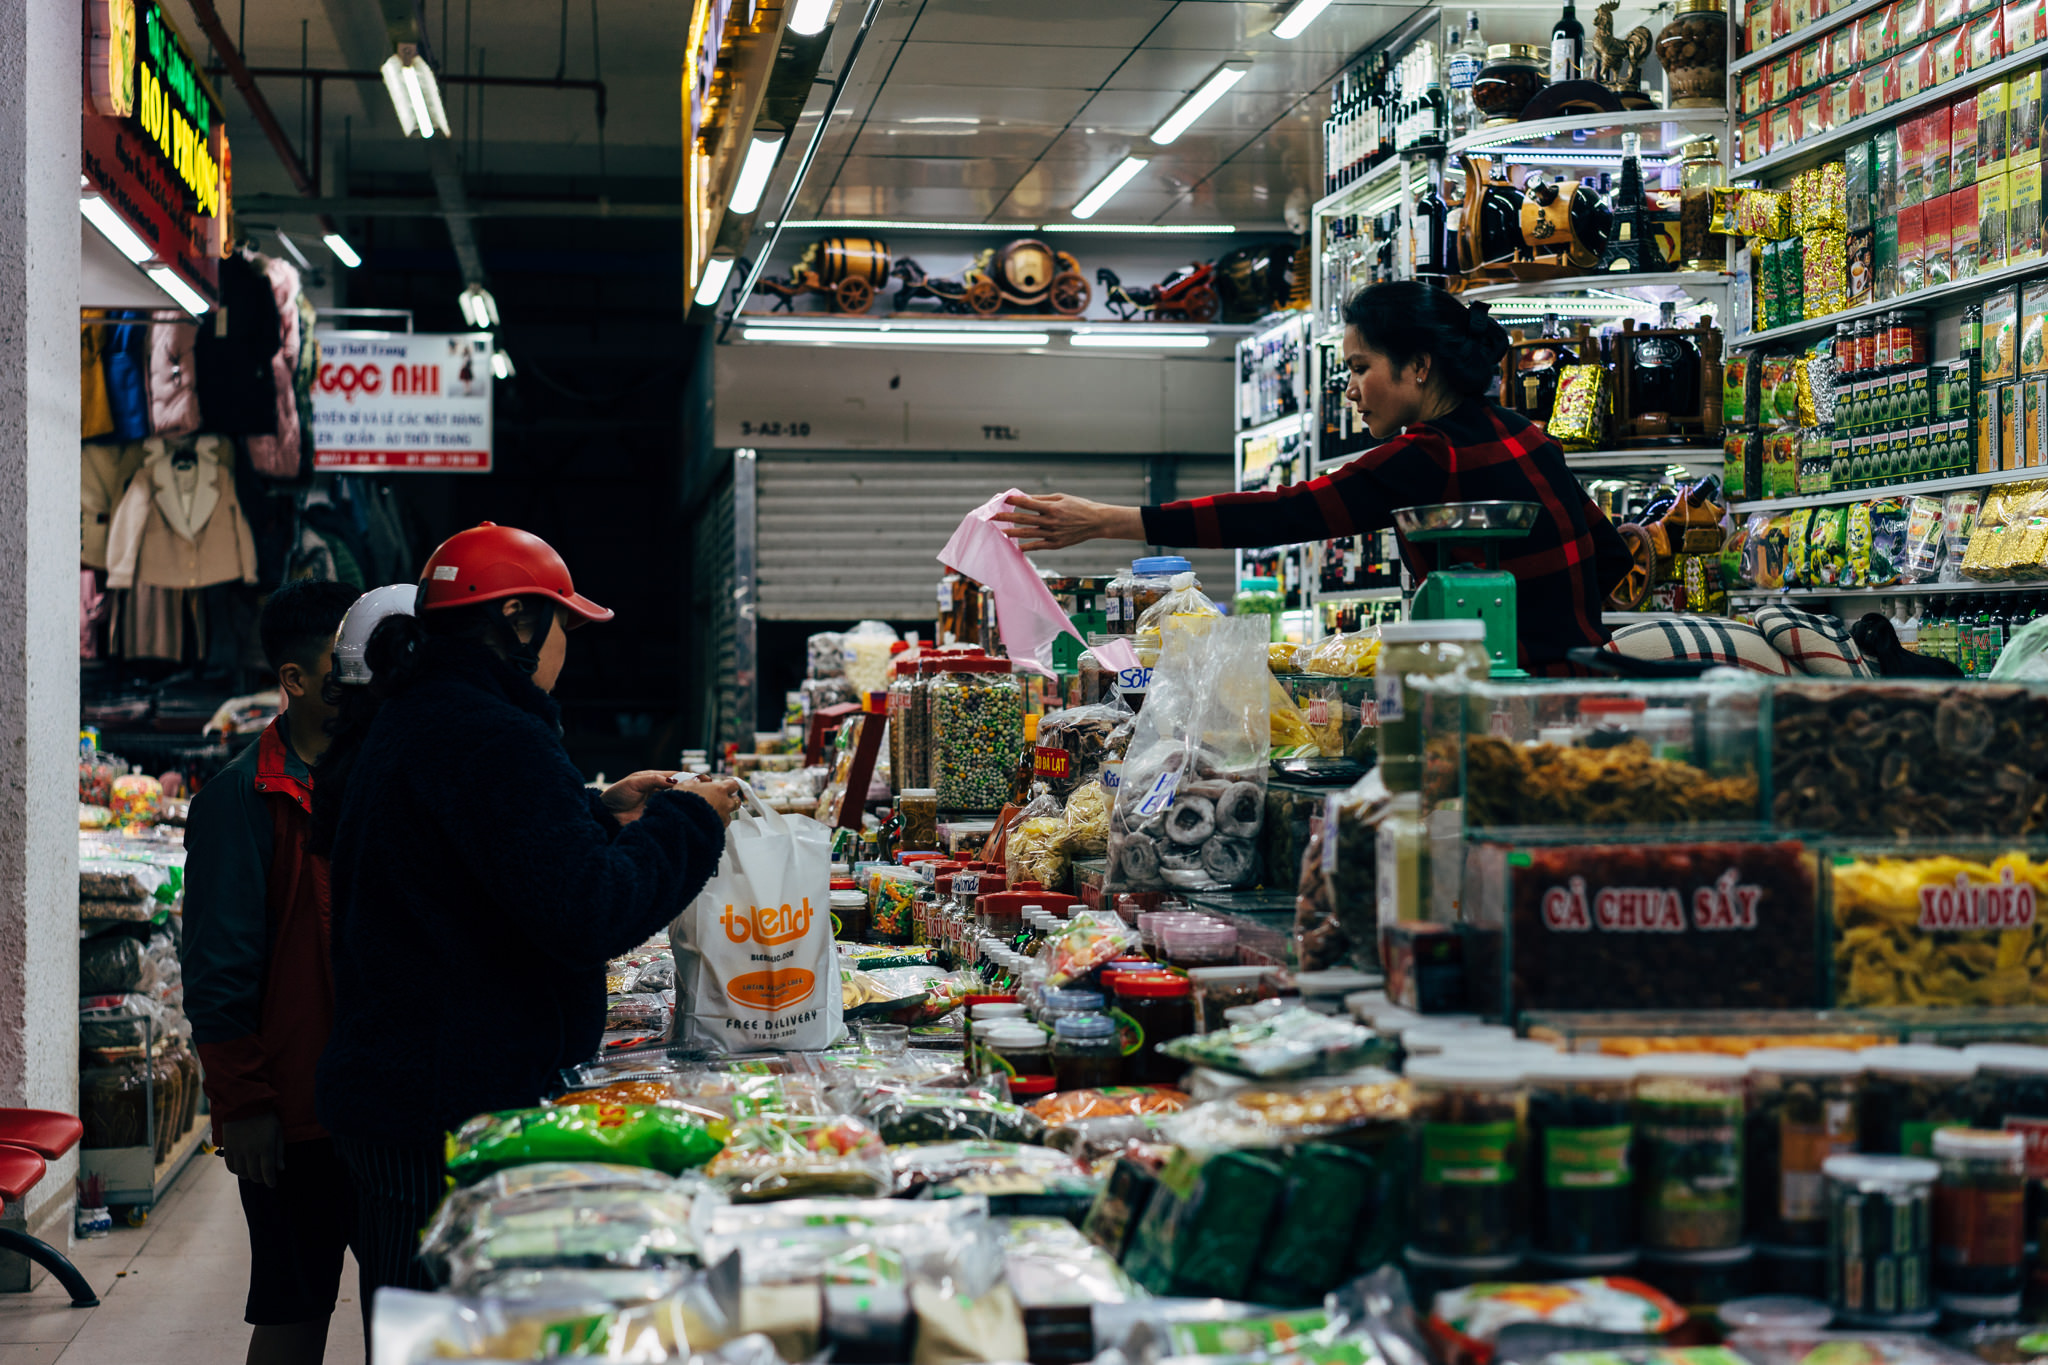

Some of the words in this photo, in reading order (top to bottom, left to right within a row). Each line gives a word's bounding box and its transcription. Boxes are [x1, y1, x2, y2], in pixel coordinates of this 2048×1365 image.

[141, 61, 170, 159] HOA
[310, 362, 382, 403] GỌC
[392, 363, 440, 395] NHI
[740, 422, 811, 436] 3-A2-10
[982, 425, 1020, 440] TEL:
[1051, 757, 1067, 775] LẠT
[1594, 886, 1687, 932] CHUA
[1693, 867, 1762, 931] SẤY
[720, 897, 813, 946] blend
[726, 1018, 758, 1030] FREE
[765, 1010, 817, 1030] DELIVERY
